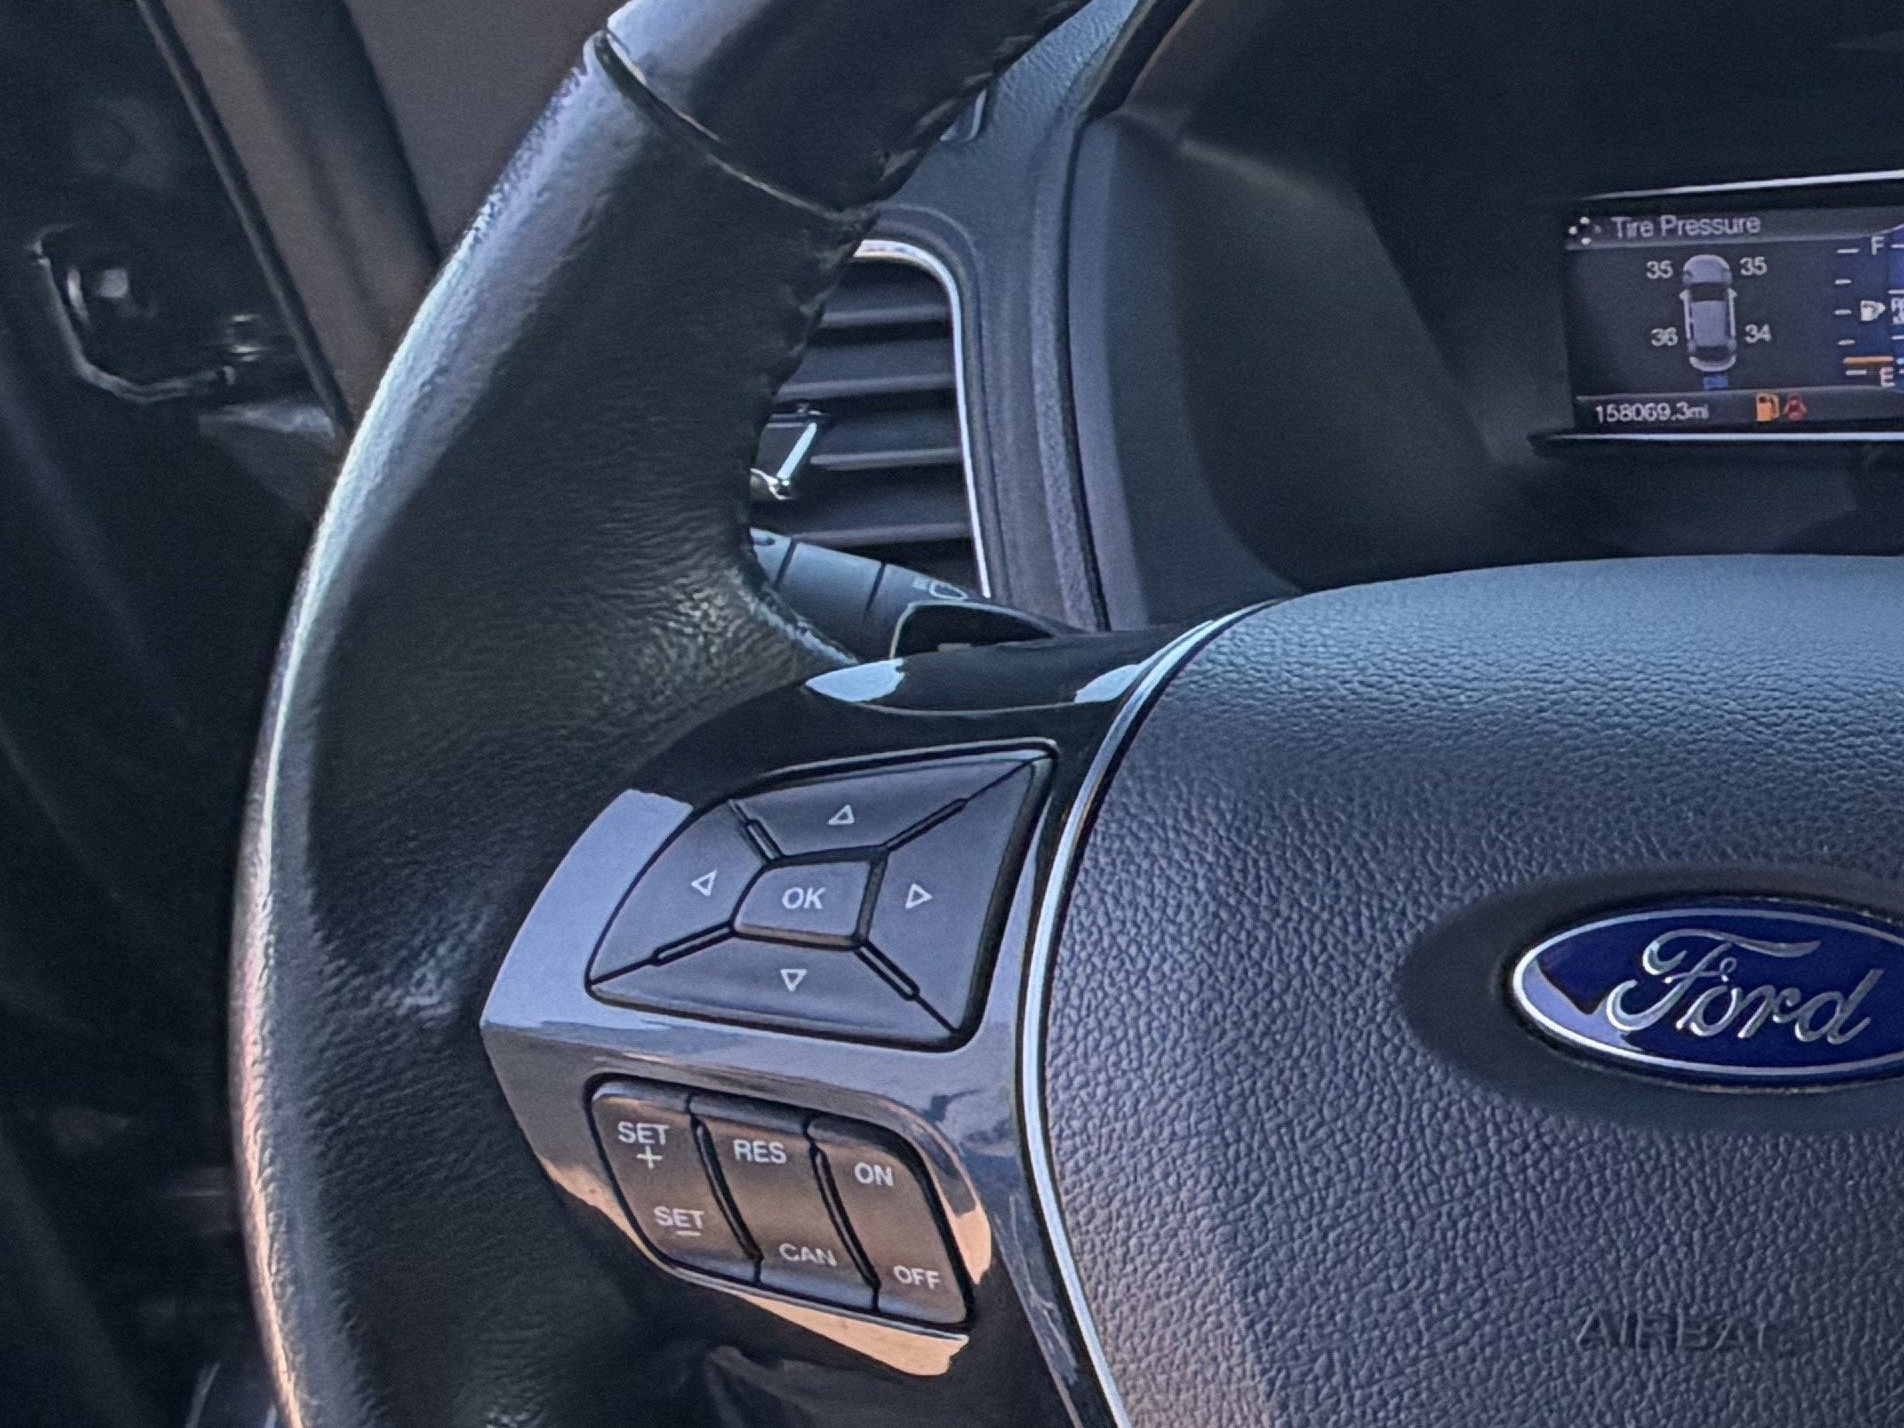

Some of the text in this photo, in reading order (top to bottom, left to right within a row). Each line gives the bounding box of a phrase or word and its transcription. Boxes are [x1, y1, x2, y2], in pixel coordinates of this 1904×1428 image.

[1610, 214, 1762, 239] Tire Pressure
[1871, 235, 1884, 255] F
[1646, 260, 1674, 280] 35
[1740, 257, 1768, 276] 35
[1744, 324, 1772, 344] 34
[1880, 366, 1896, 387] E
[781, 887, 825, 912] OK
[1606, 928, 1887, 1045] Ford
[617, 1121, 669, 1147] SET
[733, 1138, 787, 1164] RES
[854, 1163, 894, 1187] ON
[653, 1206, 704, 1232] SET
[778, 1242, 837, 1267] CAN
[893, 1264, 941, 1291] OFF
